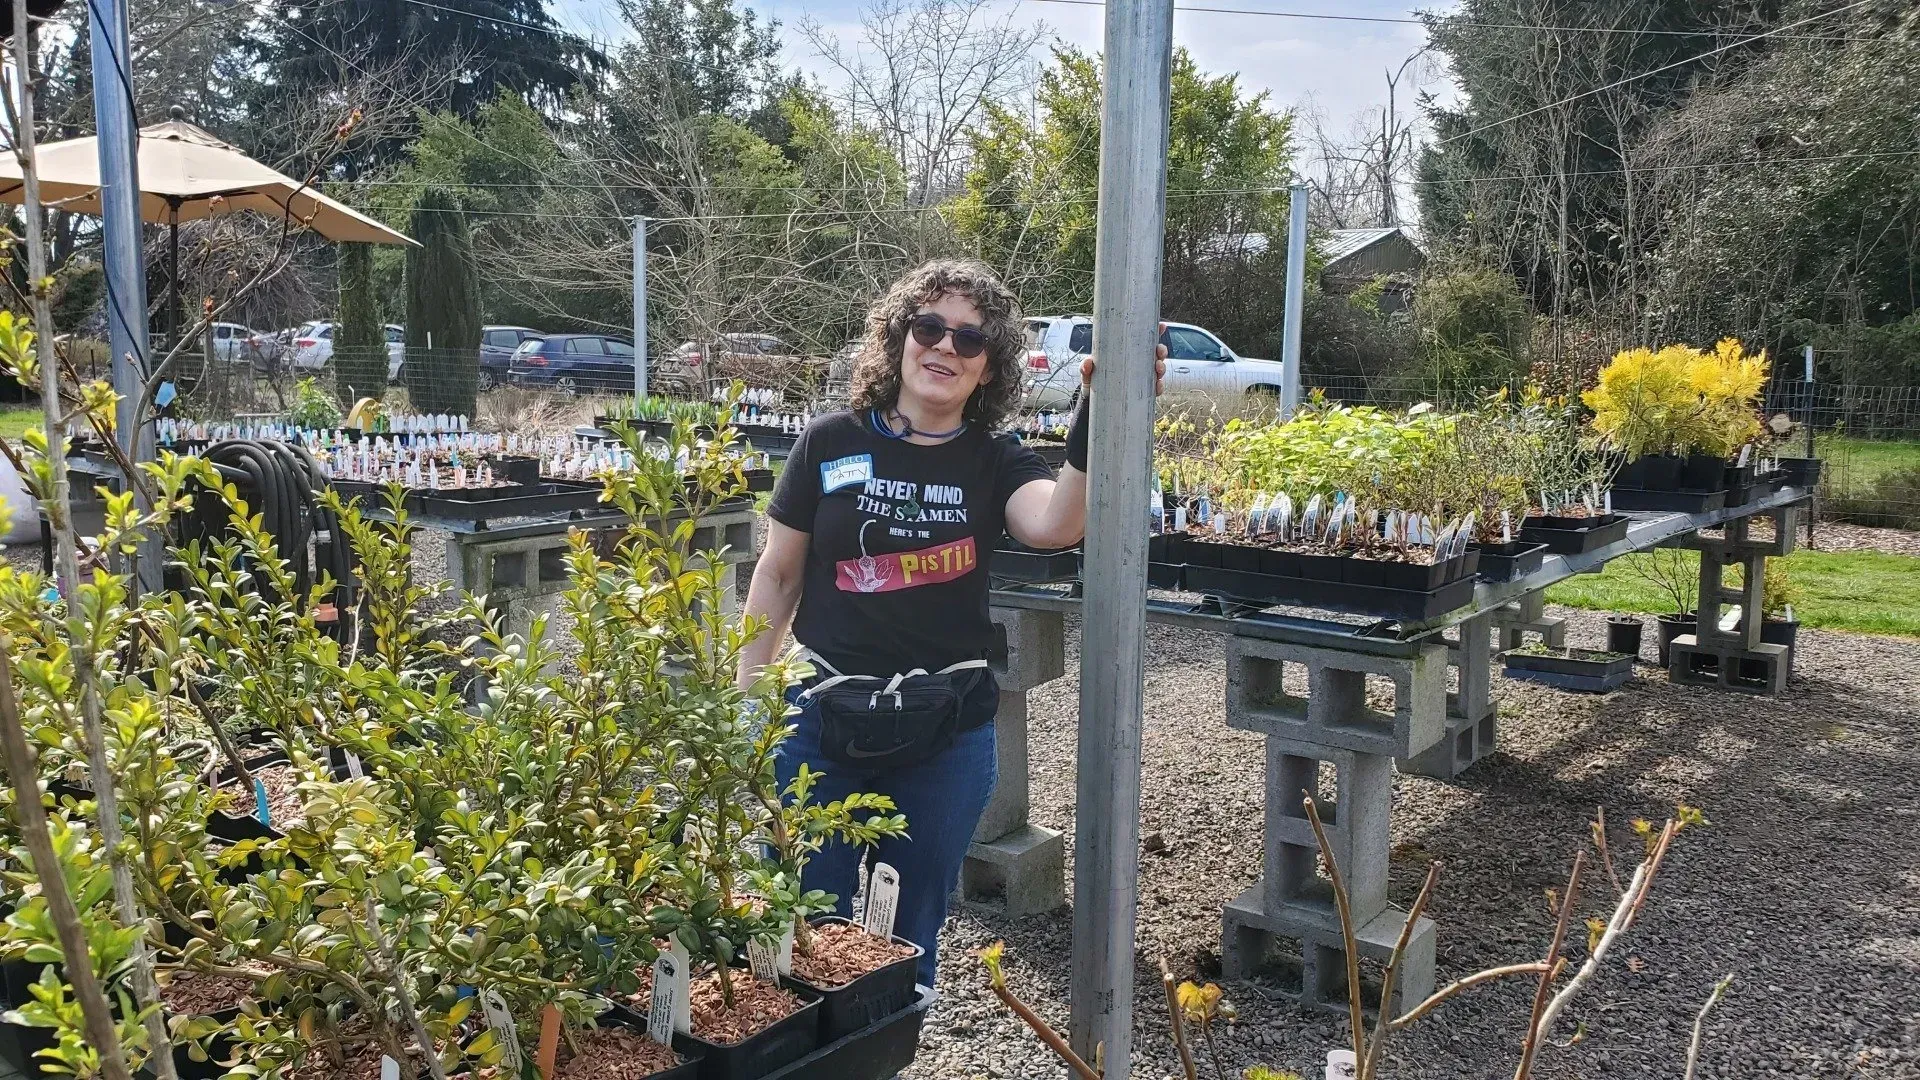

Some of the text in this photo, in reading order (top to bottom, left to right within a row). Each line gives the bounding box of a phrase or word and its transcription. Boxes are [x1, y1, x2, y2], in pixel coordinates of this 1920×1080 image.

[829, 455, 864, 470] HELLO
[829, 465, 868, 484] PATTY
[923, 484, 963, 505] MIND
[856, 494, 968, 524] THE SAMEN
[889, 526, 930, 539] HERE'S THE
